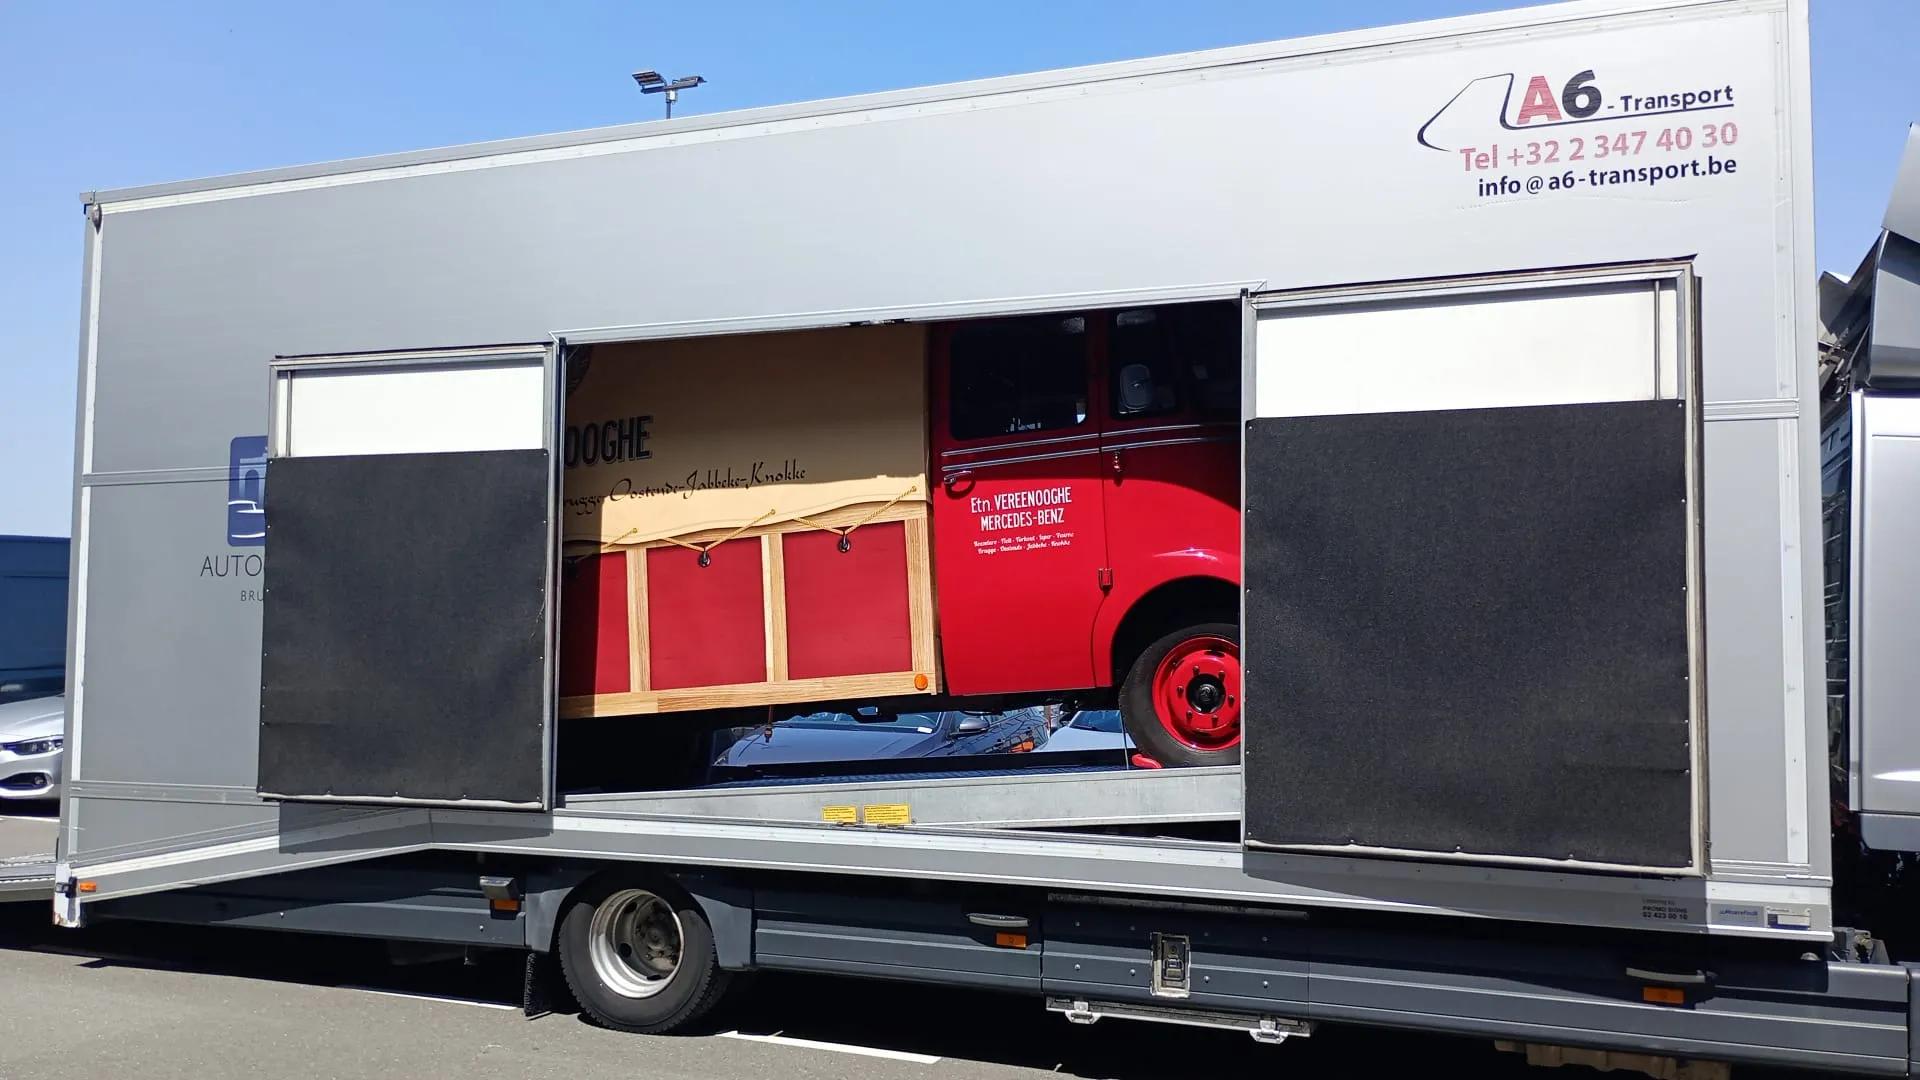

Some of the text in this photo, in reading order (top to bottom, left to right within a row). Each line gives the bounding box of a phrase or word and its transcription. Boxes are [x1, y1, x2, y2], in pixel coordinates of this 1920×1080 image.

[1517, 70, 1602, 125] A6
[1620, 85, 1734, 112] Transport
[1460, 121, 1738, 171] Tel +32 2 347 40 30
[564, 415, 653, 468] OOGHE
[971, 486, 1072, 513] Etn. VEREENOOGHE
[980, 508, 1065, 531] MERCEDES-BENZ
[200, 554, 262, 577] AUTO
[241, 590, 264, 602] BRU
